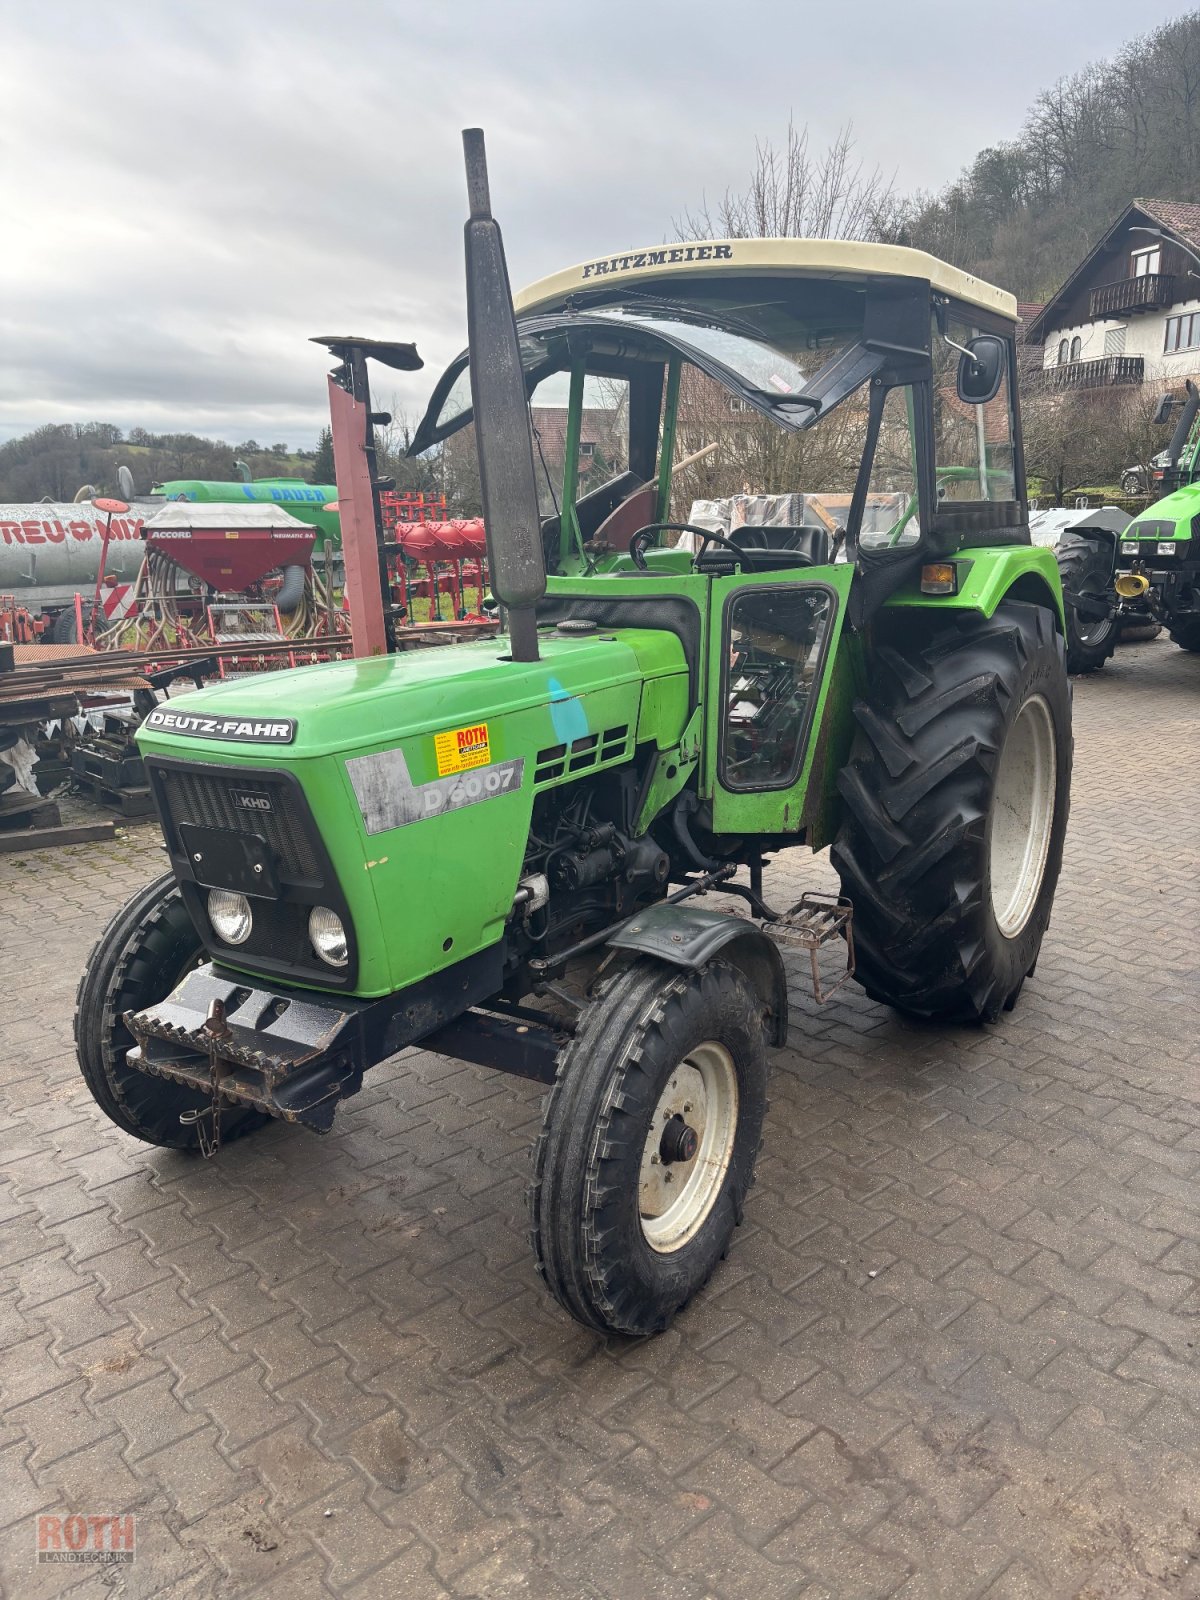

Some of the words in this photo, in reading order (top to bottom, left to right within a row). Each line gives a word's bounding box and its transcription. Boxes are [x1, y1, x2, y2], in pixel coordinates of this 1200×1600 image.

[582, 244, 733, 279] FRITZMEIER
[270, 488, 327, 502] BAUER
[151, 531, 192, 539] ACCORD
[150, 712, 290, 738] DEUTZ-FAHR
[457, 725, 488, 748] ROTH
[240, 796, 271, 810] KHD
[423, 788, 443, 811] D
